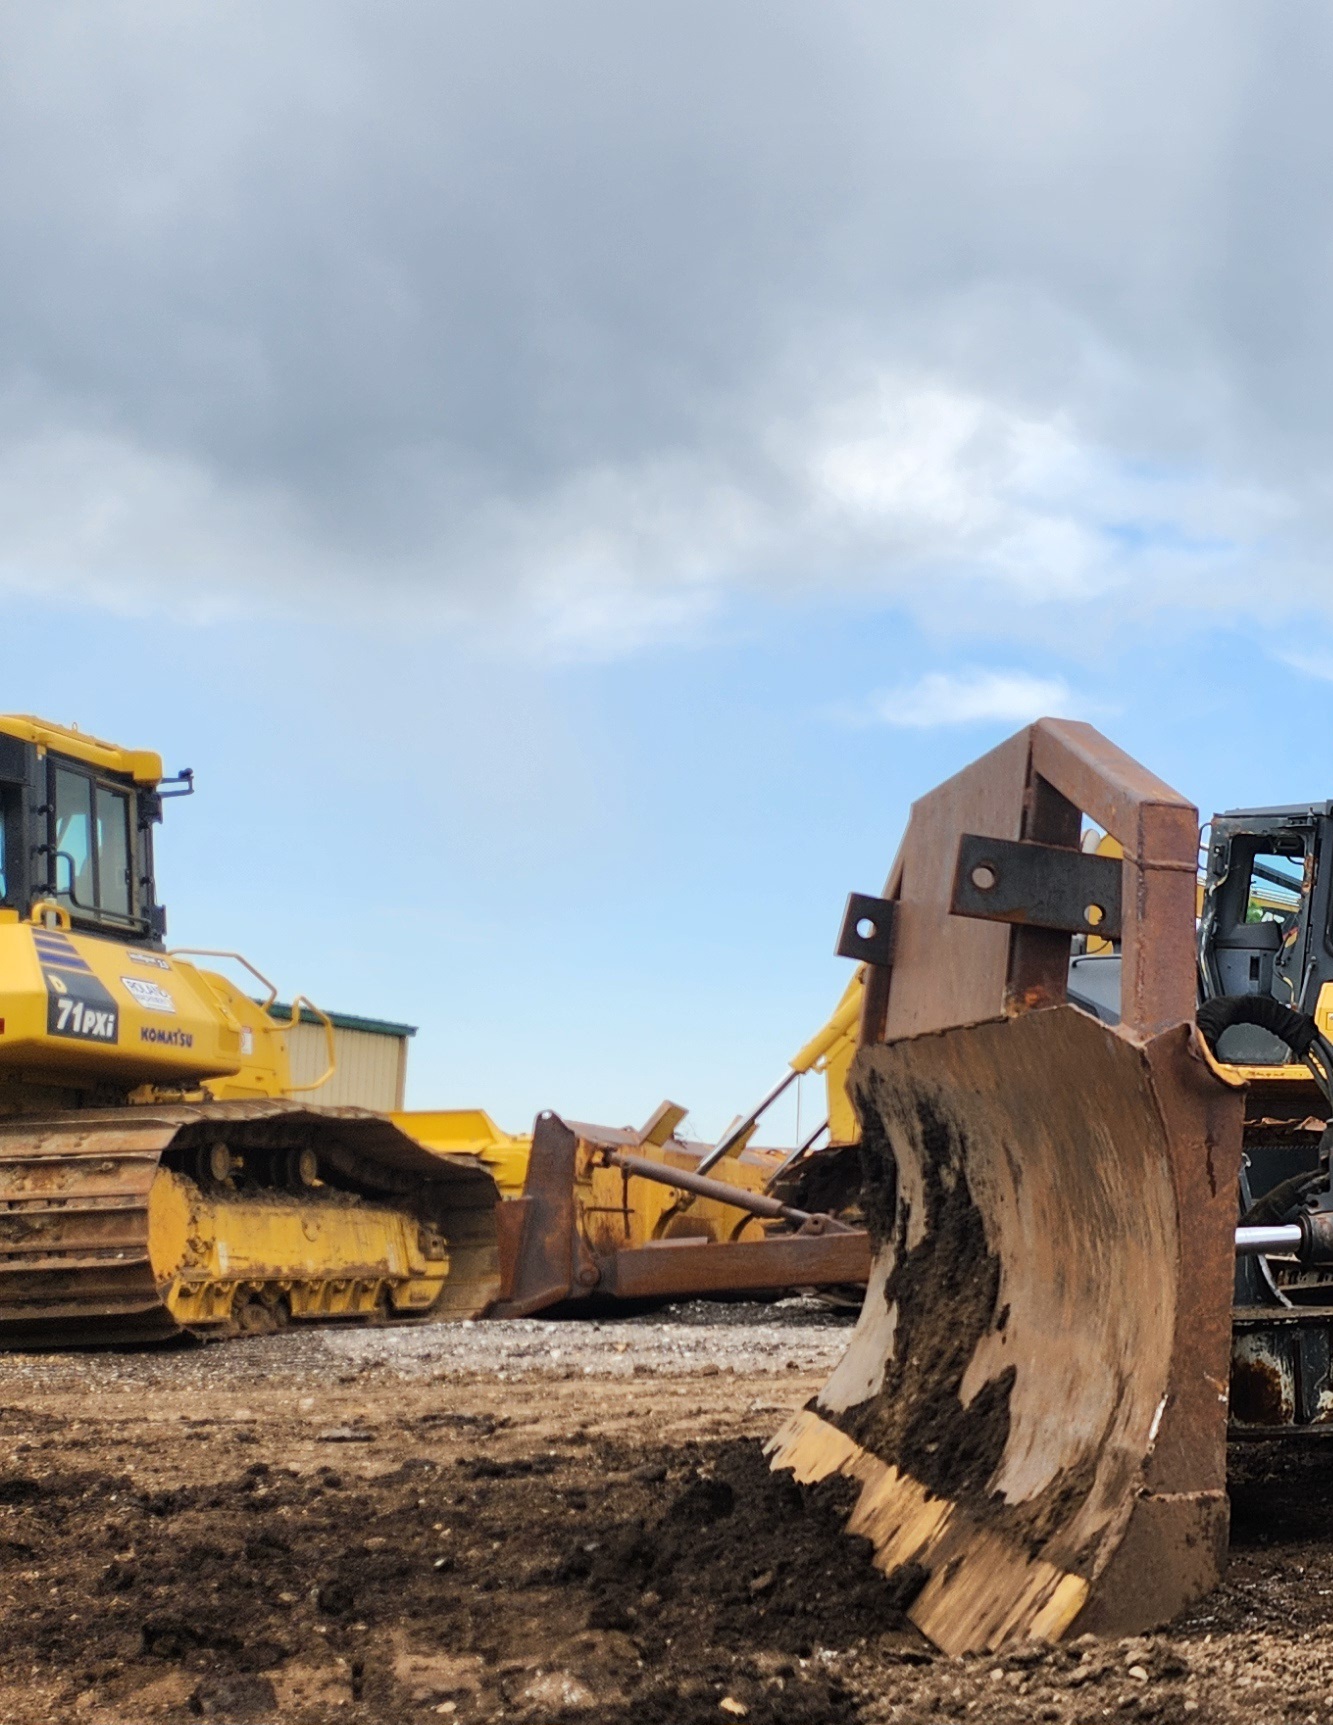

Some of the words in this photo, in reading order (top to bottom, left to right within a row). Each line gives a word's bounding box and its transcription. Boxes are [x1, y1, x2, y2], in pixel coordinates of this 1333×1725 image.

[48, 974, 68, 994] D
[55, 997, 115, 1039] 71PXi
[141, 1026, 194, 1048] KOMATSU
